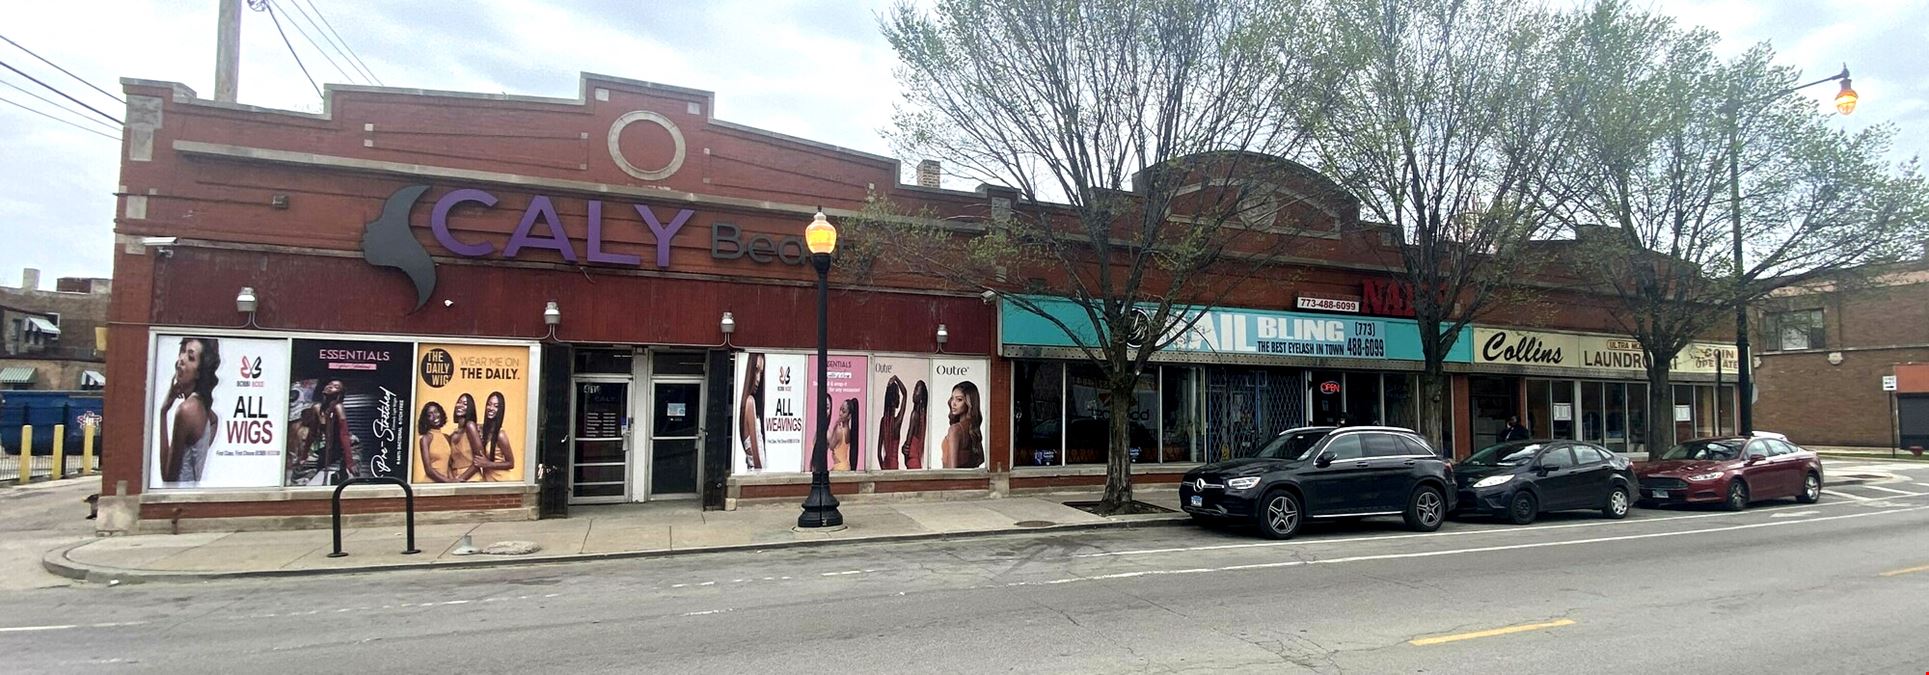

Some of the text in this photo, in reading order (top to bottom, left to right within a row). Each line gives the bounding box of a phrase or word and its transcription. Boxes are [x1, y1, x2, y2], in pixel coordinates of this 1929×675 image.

[430, 188, 850, 268] CALY Bea
[1300, 298, 1356, 310] 773-488-6099
[1257, 316, 1345, 342] BLING
[1354, 321, 1376, 336] (773)
[1257, 338, 1385, 357] THE BEST EYELASH IN TOWN 488-6099
[1482, 331, 1564, 364] Collins
[1609, 341, 1630, 349] ULTRA
[319, 349, 390, 361] ESSENTIALS
[428, 351, 443, 362] THE
[1703, 348, 1734, 359] COIN
[460, 357, 519, 367] WEAR ME ON
[1584, 350, 1678, 370] LAUNDROT
[1695, 359, 1739, 369] OPEATE
[426, 363, 449, 374] DAILY
[460, 368, 520, 380] THE DAILY.
[875, 363, 892, 373] Outre
[936, 365, 967, 376] Outre
[1321, 383, 1340, 392] OPEN
[233, 396, 268, 418] ALL
[775, 398, 793, 416] ALL
[766, 418, 802, 432] WEAVINGS
[226, 420, 273, 444] WIGS
